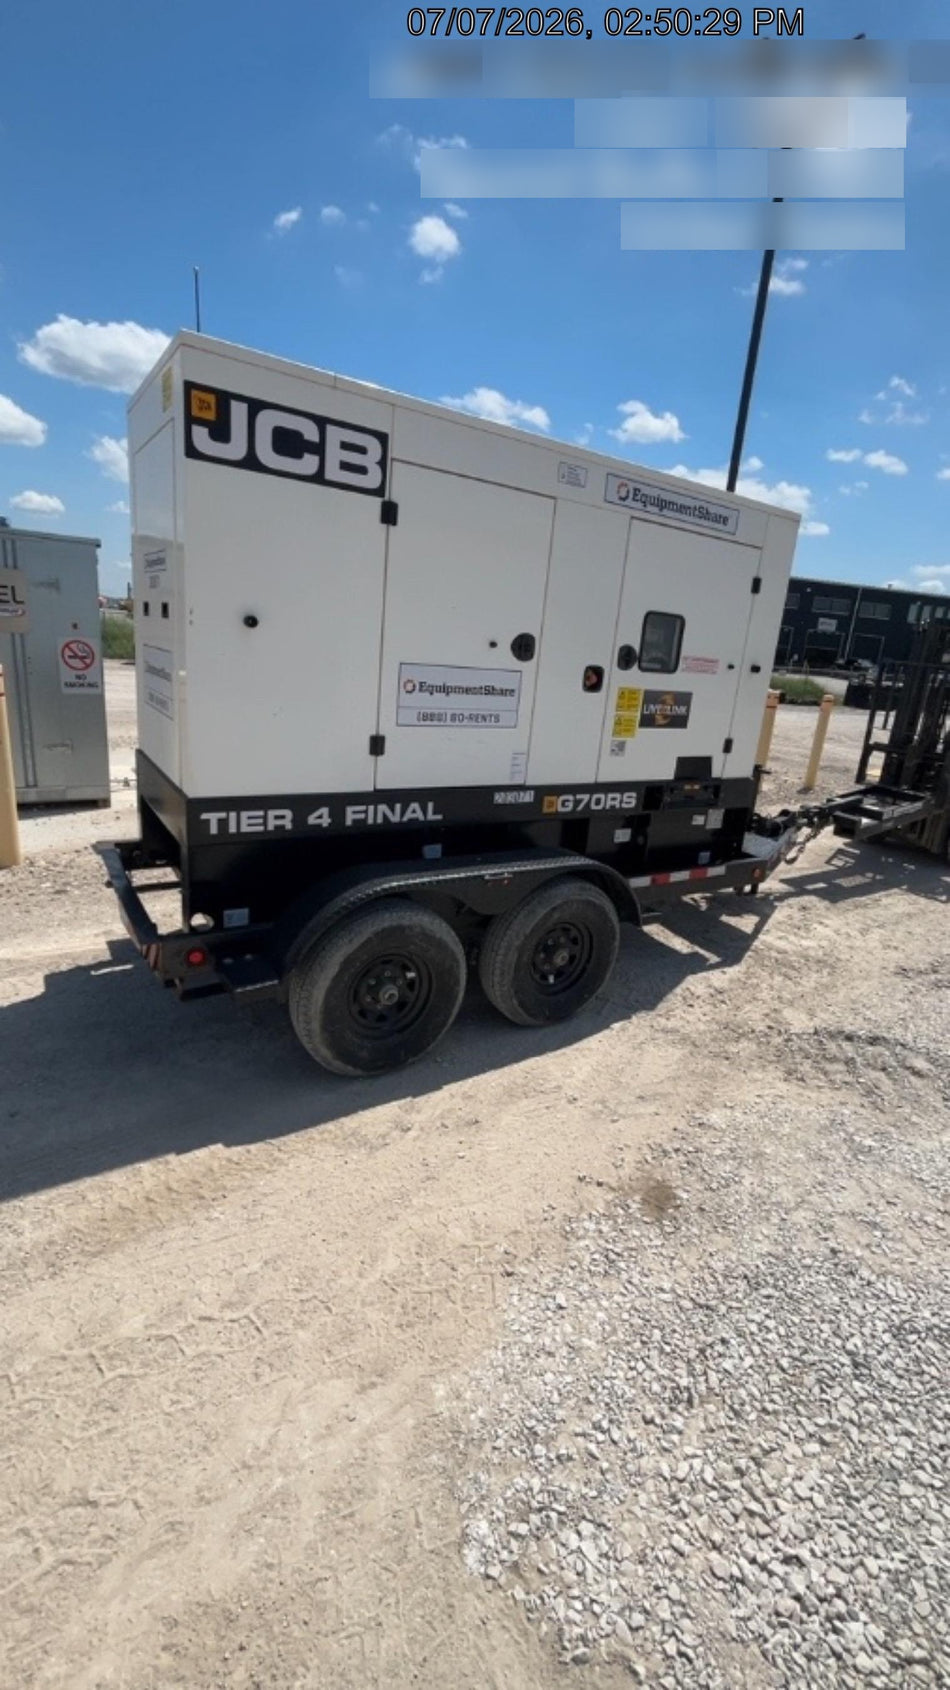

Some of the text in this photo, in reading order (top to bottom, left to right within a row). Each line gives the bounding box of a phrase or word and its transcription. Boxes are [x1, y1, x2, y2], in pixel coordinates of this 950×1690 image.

[191, 399, 384, 490] JCB
[631, 487, 730, 527] EquipmentShare
[418, 681, 516, 697] EquipmentShare
[200, 801, 444, 835] TIER 4 FINAL
[556, 791, 638, 812] G70RS
